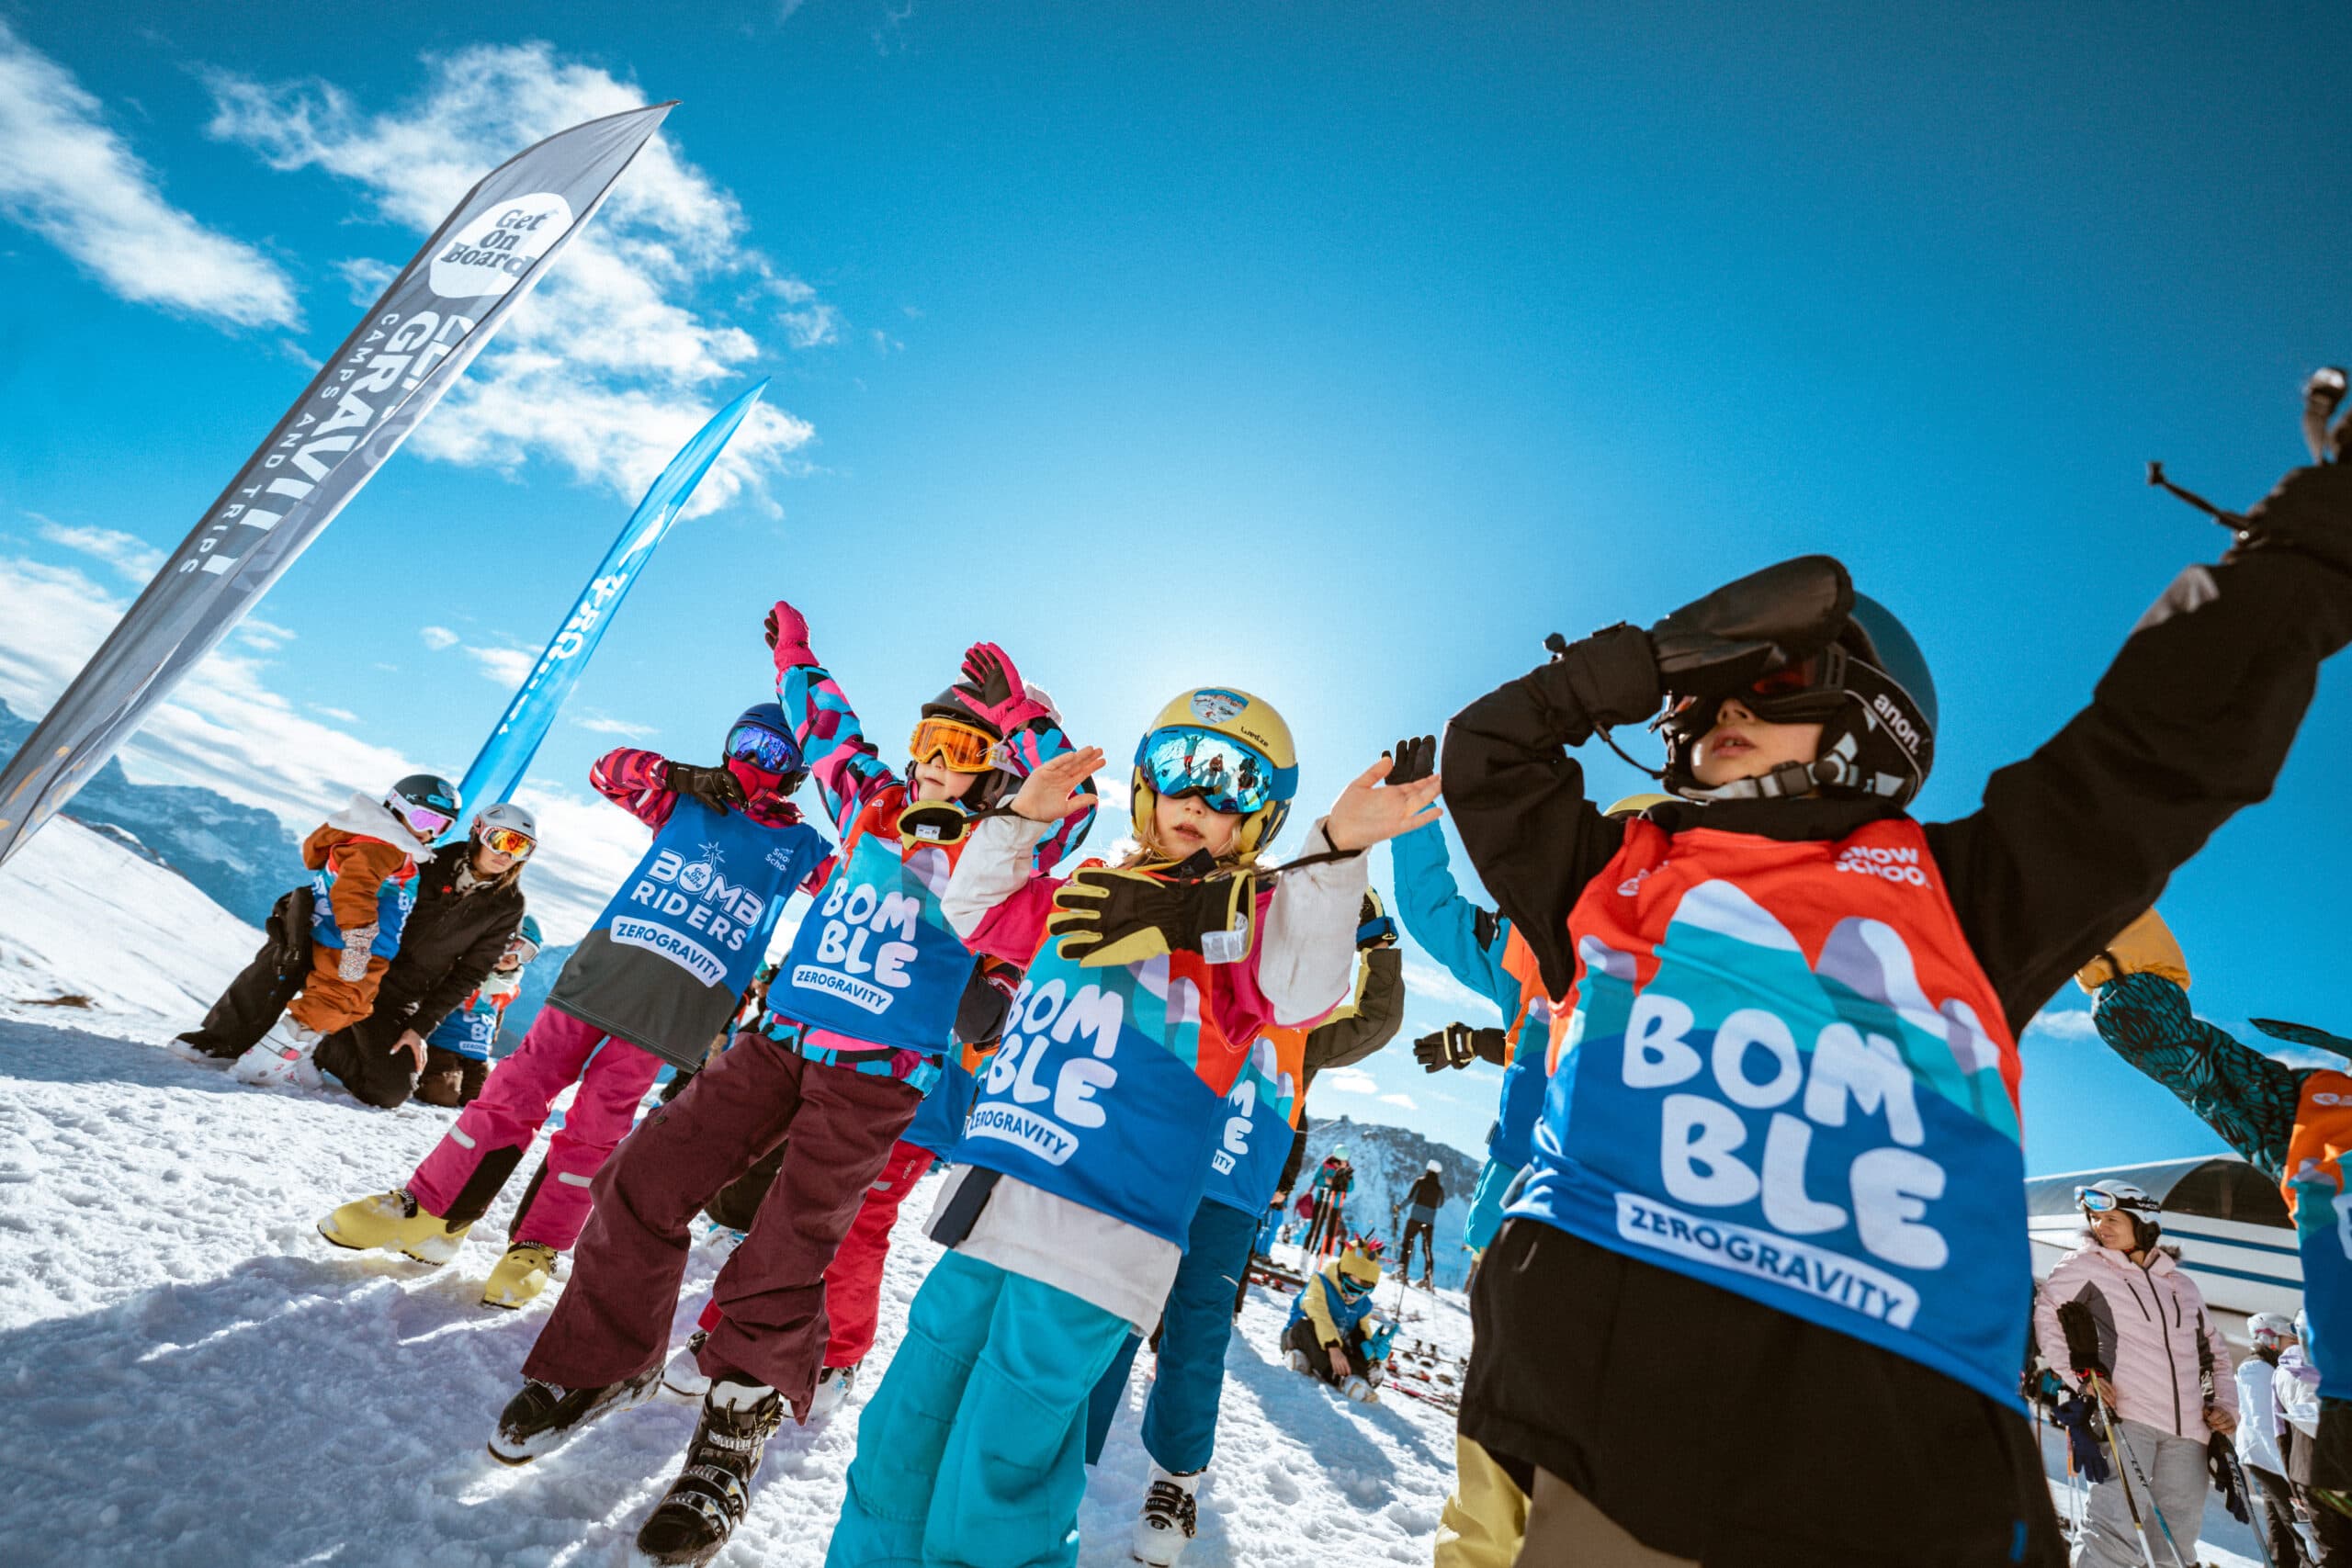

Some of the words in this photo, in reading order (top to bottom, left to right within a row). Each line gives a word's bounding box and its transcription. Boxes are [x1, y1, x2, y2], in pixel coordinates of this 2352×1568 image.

[479, 230, 521, 251] On
[496, 209, 549, 231] Get
[440, 243, 539, 278] Board
[321, 313, 400, 399] CAMPS
[265, 412, 317, 468] AND
[179, 484, 263, 573] TRIPS
[645, 848, 765, 927] BOMB
[764, 853, 787, 873] Scho
[773, 847, 791, 863] Sno
[1835, 859, 1934, 890] SCHOO
[630, 881, 747, 951] RIDERS
[821, 877, 920, 942] BOM
[616, 922, 720, 980] ZEROGRAVITY
[817, 919, 919, 988] BLE
[796, 970, 888, 1008] ZEROGRAVITY
[1002, 978, 1124, 1059] BOM
[986, 1033, 1118, 1129] BLE
[1623, 994, 1925, 1145] BOM
[969, 1110, 1069, 1156] ZEROGRAVITY
[1661, 1094, 1948, 1269] BLE
[1630, 1205, 1903, 1321] ZEROGRAVITY
